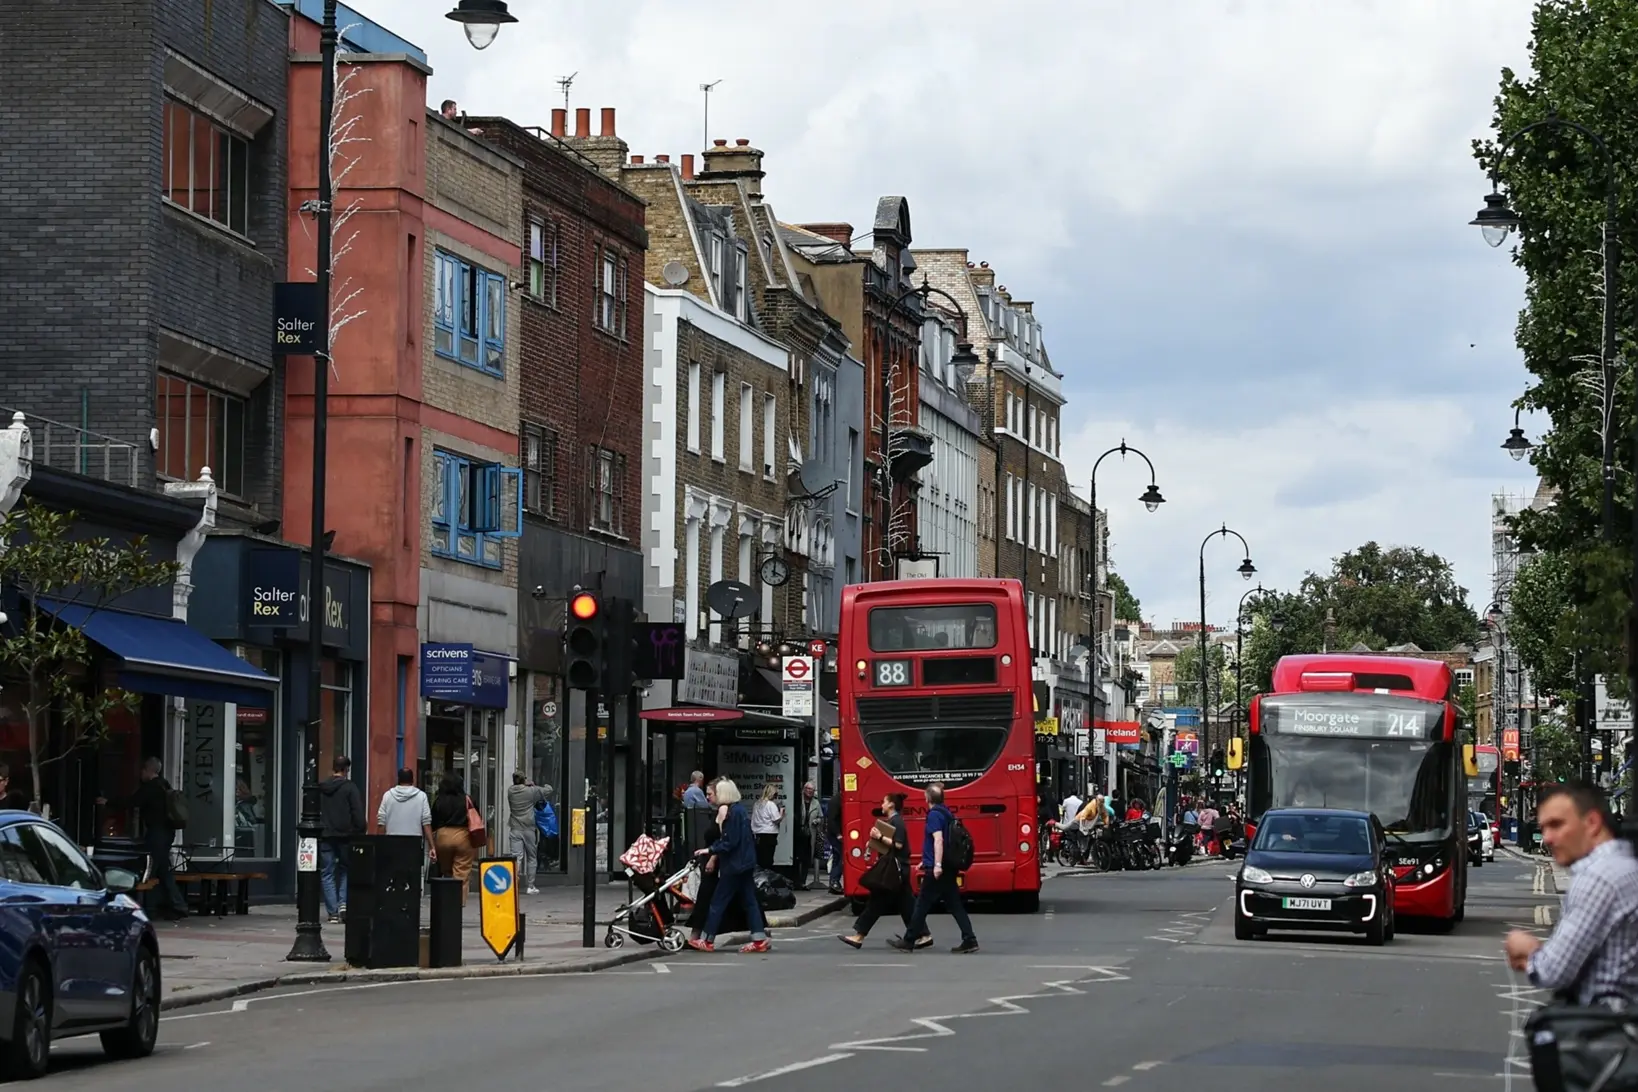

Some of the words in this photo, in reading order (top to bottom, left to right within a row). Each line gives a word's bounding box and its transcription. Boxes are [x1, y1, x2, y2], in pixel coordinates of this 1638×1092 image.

[277, 317, 315, 331] Salter
[277, 331, 301, 343] Rex
[254, 586, 295, 602] Salter
[254, 601, 280, 616] Rex
[325, 585, 343, 629] Rex
[426, 648, 468, 658] scrivens
[811, 644, 823, 652] KE
[880, 662, 905, 684] 88
[1294, 710, 1359, 725] Moorgate
[1294, 724, 1327, 732] FINSBURY
[1329, 726, 1358, 734] SQUARE
[1387, 713, 1420, 736] 214
[1106, 727, 1137, 738] Iceland
[195, 704, 215, 804] AGENTS
[1007, 763, 1025, 771] EH34
[765, 772, 784, 780] here
[1398, 857, 1419, 865] SEe91
[1290, 899, 1309, 908] MJ71
[1311, 899, 1329, 909] UVT
